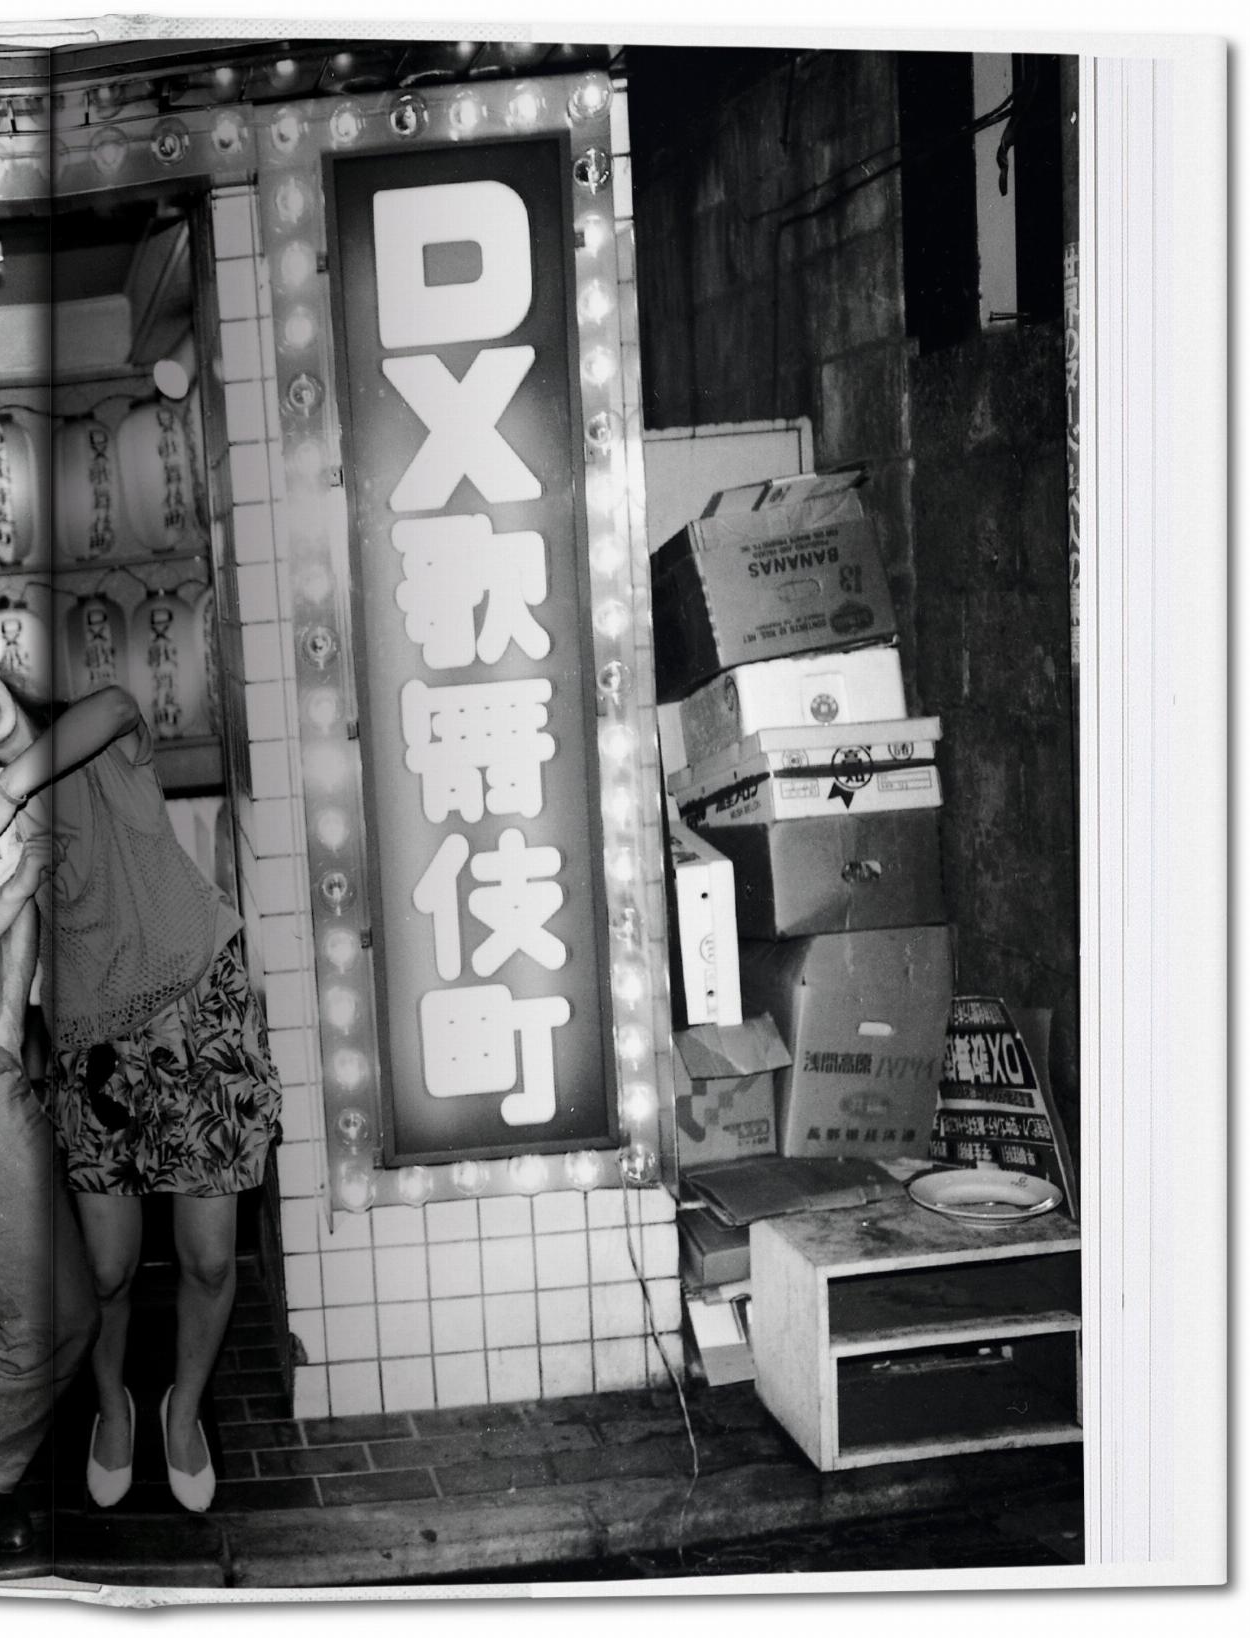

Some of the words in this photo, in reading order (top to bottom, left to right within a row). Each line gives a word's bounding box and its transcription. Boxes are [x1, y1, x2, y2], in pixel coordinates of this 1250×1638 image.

[372, 179, 571, 1127] DX歌舞伎町
[748, 546, 839, 578] BANANAS
